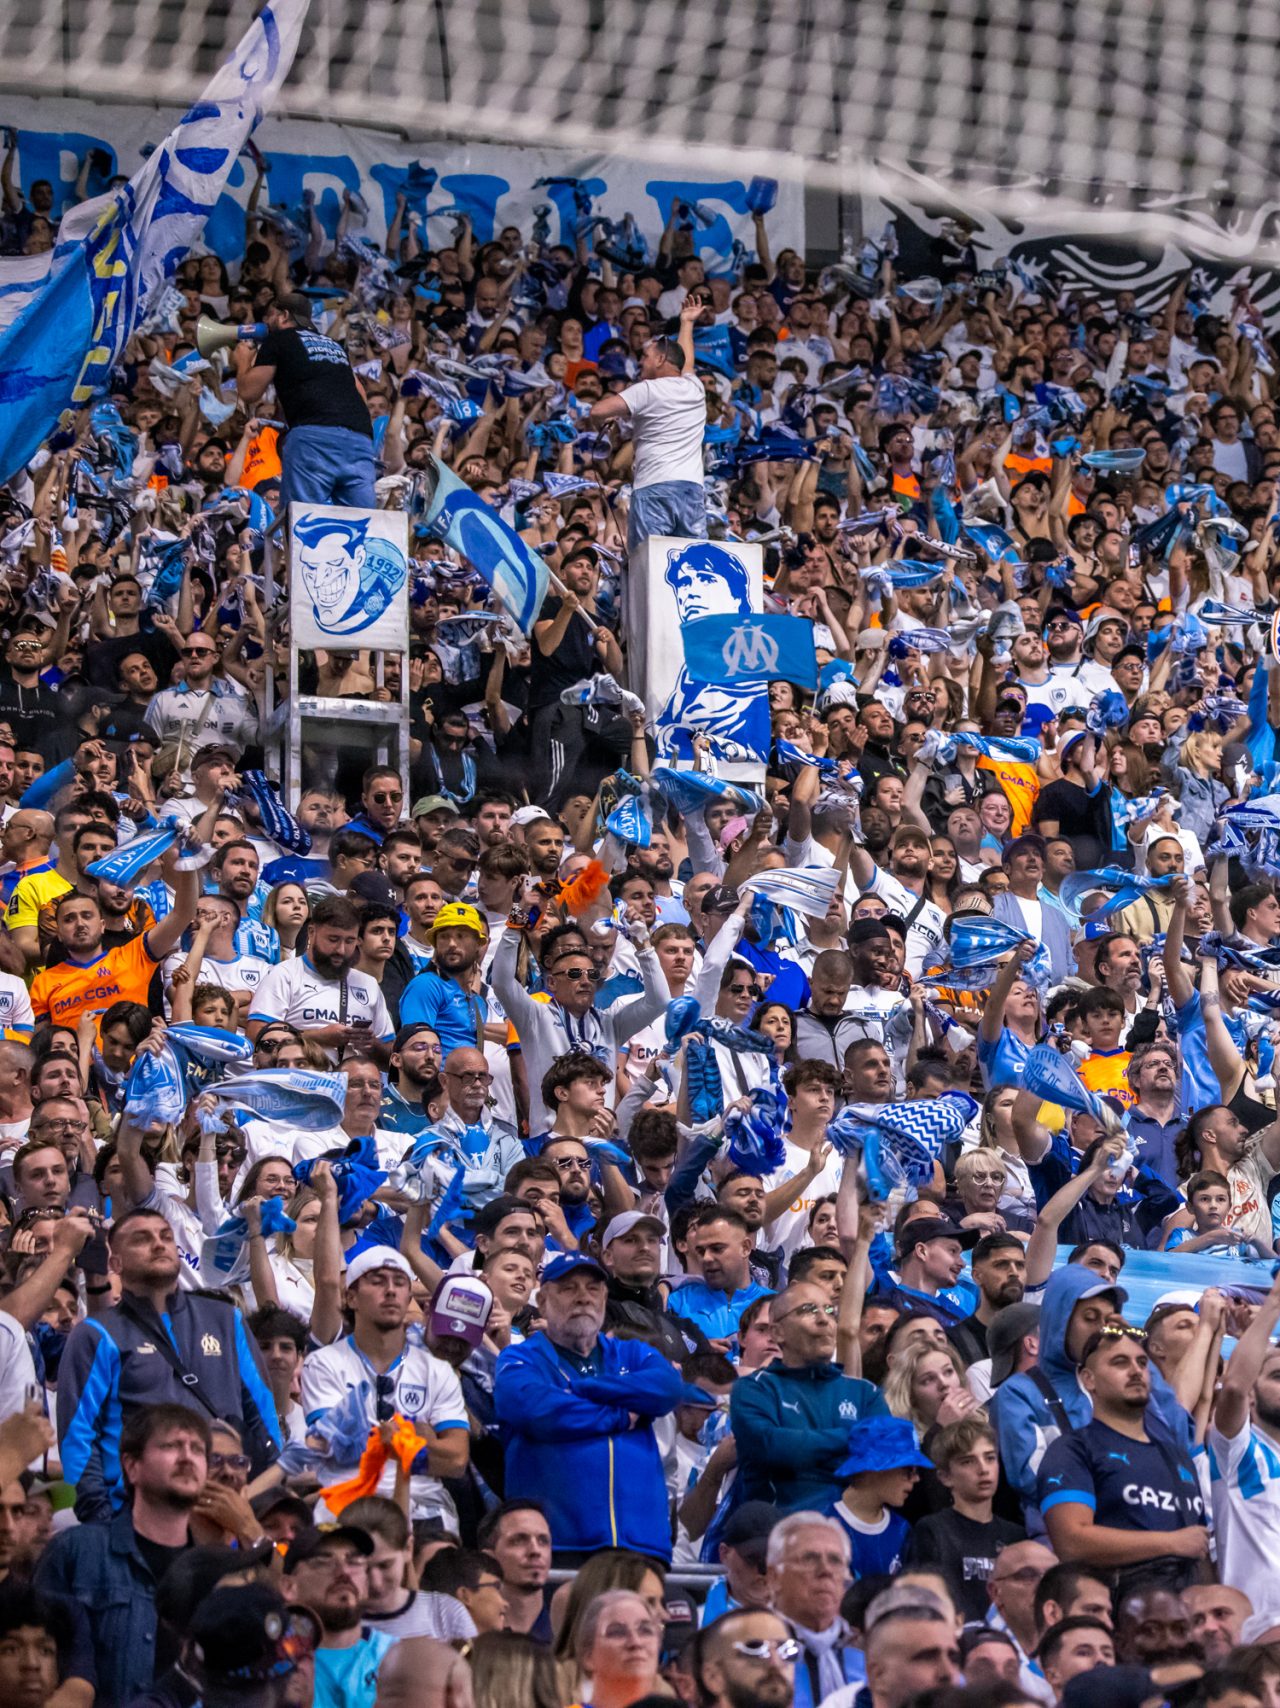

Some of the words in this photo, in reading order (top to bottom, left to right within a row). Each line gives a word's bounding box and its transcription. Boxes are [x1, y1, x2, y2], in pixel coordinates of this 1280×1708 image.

[367, 555, 402, 581] 1992
[54, 995, 83, 1012] CMA
[84, 984, 120, 1001] CGM
[302, 1008, 338, 1021] CMA
